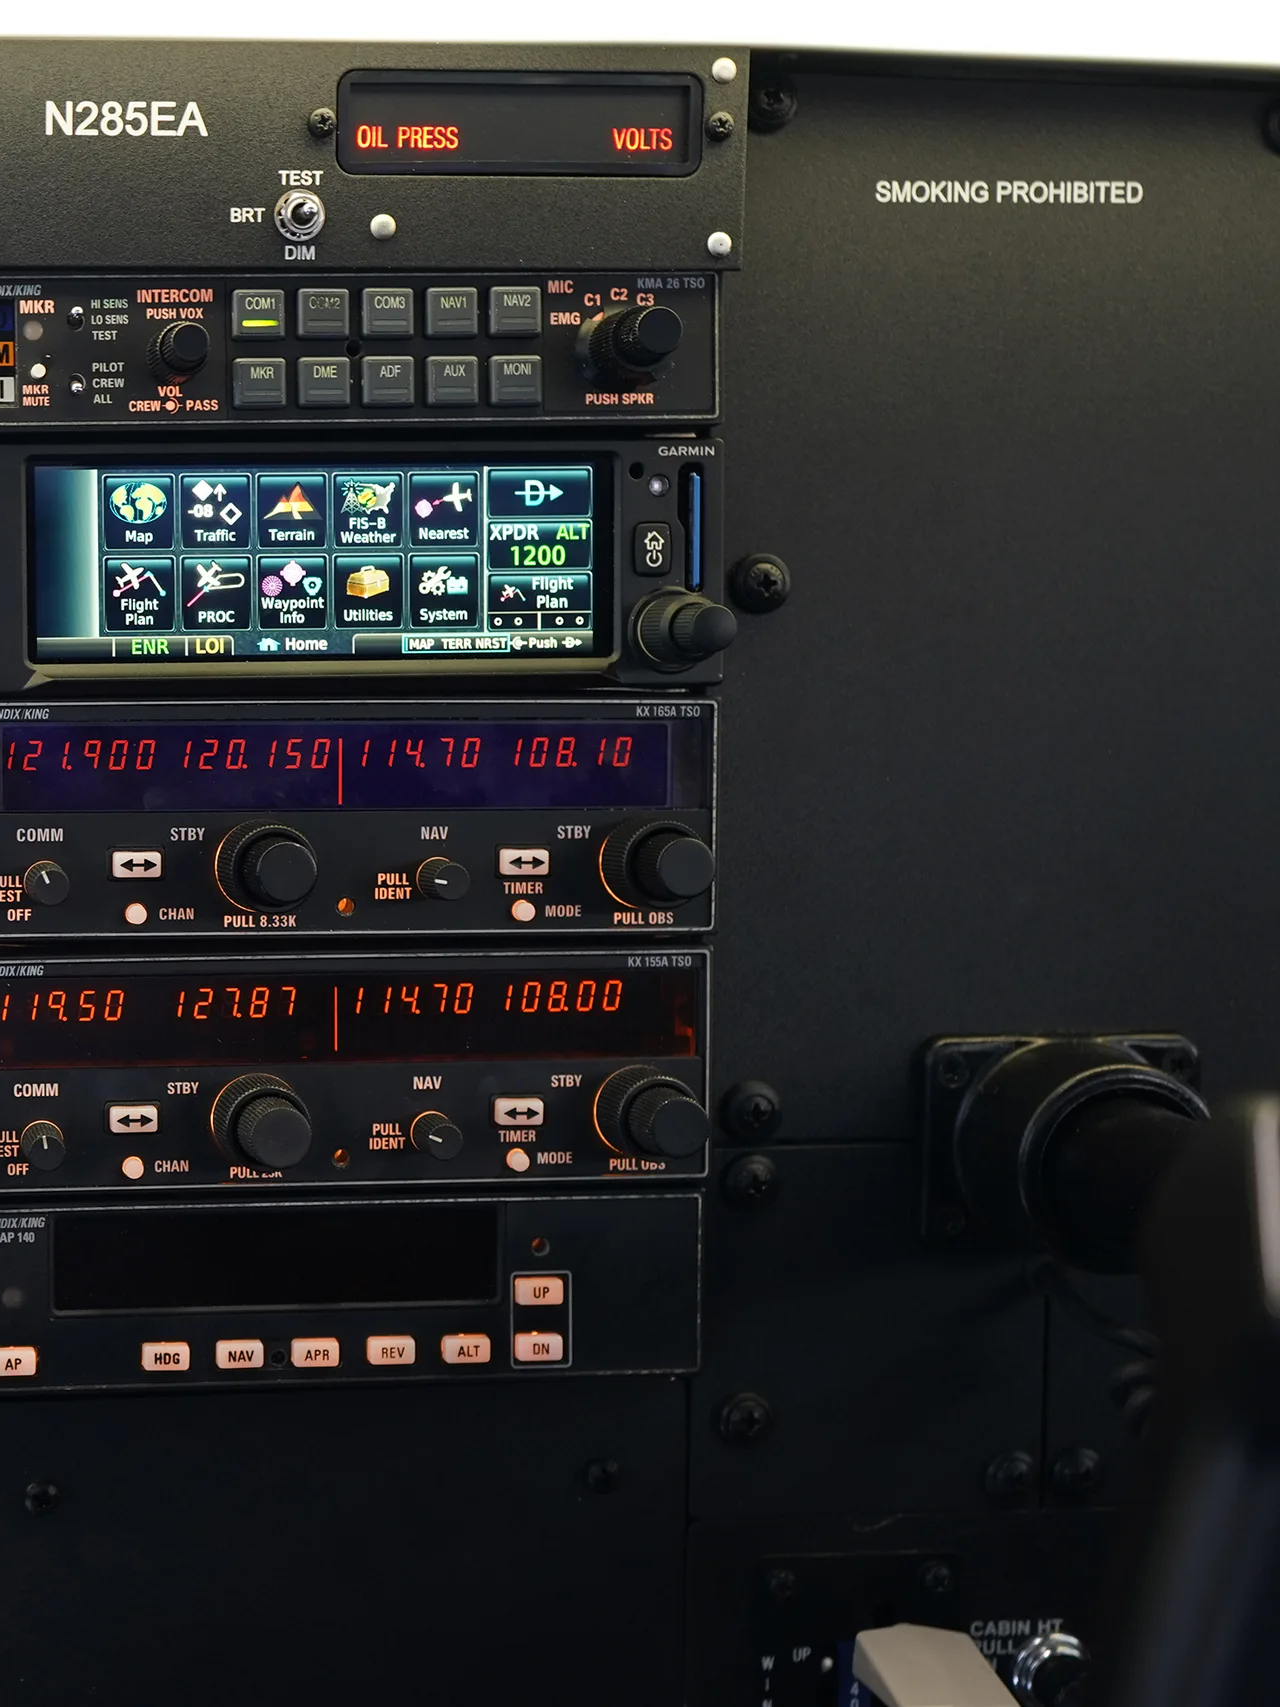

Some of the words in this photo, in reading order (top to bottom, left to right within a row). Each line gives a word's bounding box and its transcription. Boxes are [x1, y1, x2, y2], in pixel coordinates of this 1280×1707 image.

[45, 101, 208, 136] N285EA
[356, 125, 388, 149] OIL
[397, 126, 459, 149] PRESS
[613, 128, 673, 150] VOLTS
[278, 170, 323, 185] TEST
[875, 180, 989, 203] SMOKING
[996, 180, 1143, 204] PROHIBITED
[230, 208, 265, 223] BRT
[285, 246, 315, 260] DIM
[548, 281, 573, 293] MIC
[137, 289, 213, 303] INTERCOM
[375, 297, 405, 308] COM3
[441, 297, 467, 308] NAV1
[504, 295, 530, 307] NAV2
[20, 300, 54, 314] MKR
[245, 298, 275, 309] COM1
[146, 309, 177, 319] PUSH
[180, 308, 203, 318] VOX
[550, 312, 580, 325] EMG
[92, 331, 117, 340] TEST
[92, 363, 124, 372] PILOT
[251, 367, 274, 379] MKR
[313, 366, 337, 378] DME
[380, 366, 401, 377] ADF
[444, 365, 465, 376] AUX
[504, 363, 531, 375] MONI
[23, 385, 48, 394] MKR
[93, 379, 124, 388] CREW
[158, 386, 183, 397] VOL
[23, 397, 50, 406] MUTE
[94, 394, 112, 404] ALL
[186, 400, 218, 410] PASS
[586, 394, 618, 404] PUSH
[622, 393, 654, 404] SPKR
[129, 401, 161, 411] CREW
[658, 446, 715, 457] GARMIN
[349, 517, 386, 529] FIS-B
[125, 530, 153, 544] Map
[194, 530, 236, 542] Traffic
[269, 529, 315, 541] Terrain
[340, 531, 396, 544] Weather
[418, 527, 470, 540] Nearest
[489, 524, 539, 542] XPDR
[556, 523, 590, 540] ALT
[510, 545, 566, 566] 1200
[531, 577, 574, 593] Flight
[120, 598, 159, 613] Flight
[261, 597, 324, 611] Waypoint
[536, 594, 568, 609] Plan
[125, 613, 153, 625] Plan
[198, 611, 235, 623] PROC
[280, 612, 305, 624] Info
[343, 608, 393, 621] Utilities
[419, 608, 468, 622] System
[131, 639, 169, 655] ENR
[195, 638, 225, 654] LOI
[285, 637, 328, 650] Home
[409, 638, 435, 650] MAP
[441, 638, 472, 650] TERR
[475, 638, 507, 650] NRST
[528, 637, 558, 650] Push
[636, 706, 650, 716] KX
[653, 706, 677, 716] 165A
[680, 706, 701, 717] TSO
[7, 740, 156, 770] 121.900
[183, 739, 331, 770] 120.150
[361, 737, 481, 768] 114.70
[514, 736, 633, 768] 108.10
[16, 828, 64, 842] COMM
[170, 828, 205, 841] STBY
[420, 826, 449, 840] NAV
[557, 825, 592, 840] STBY
[377, 873, 409, 886] PULL
[374, 887, 412, 900] IDENT
[503, 882, 543, 895] TIMER
[7, 909, 32, 921] OFF
[159, 908, 194, 921] CHAN
[545, 905, 582, 918] MODE
[224, 915, 256, 928] PULL
[259, 915, 297, 928] 8.33K
[613, 912, 645, 925] PULL
[649, 912, 674, 925] OBS
[177, 986, 297, 1019] 127.87
[356, 983, 474, 1014] 114.70
[505, 980, 623, 1013] 108.00
[1, 989, 125, 1022] 119.50
[413, 1076, 442, 1090] NAV
[551, 1074, 582, 1088] STBY
[13, 1083, 59, 1097] COMM
[167, 1082, 199, 1095] STBY
[17, 1232, 35, 1243] 140
[533, 1286, 550, 1299] UP
[305, 1349, 330, 1362] APR
[381, 1347, 405, 1359] REV
[457, 1346, 480, 1358] ALT
[532, 1343, 550, 1356] DN
[154, 1353, 180, 1365] HDG
[228, 1350, 254, 1363] NAV
[5, 1358, 22, 1371] AP
[970, 1620, 1031, 1638] CABIN
[1037, 1618, 1064, 1634] HT
[792, 1647, 812, 1663] UP
